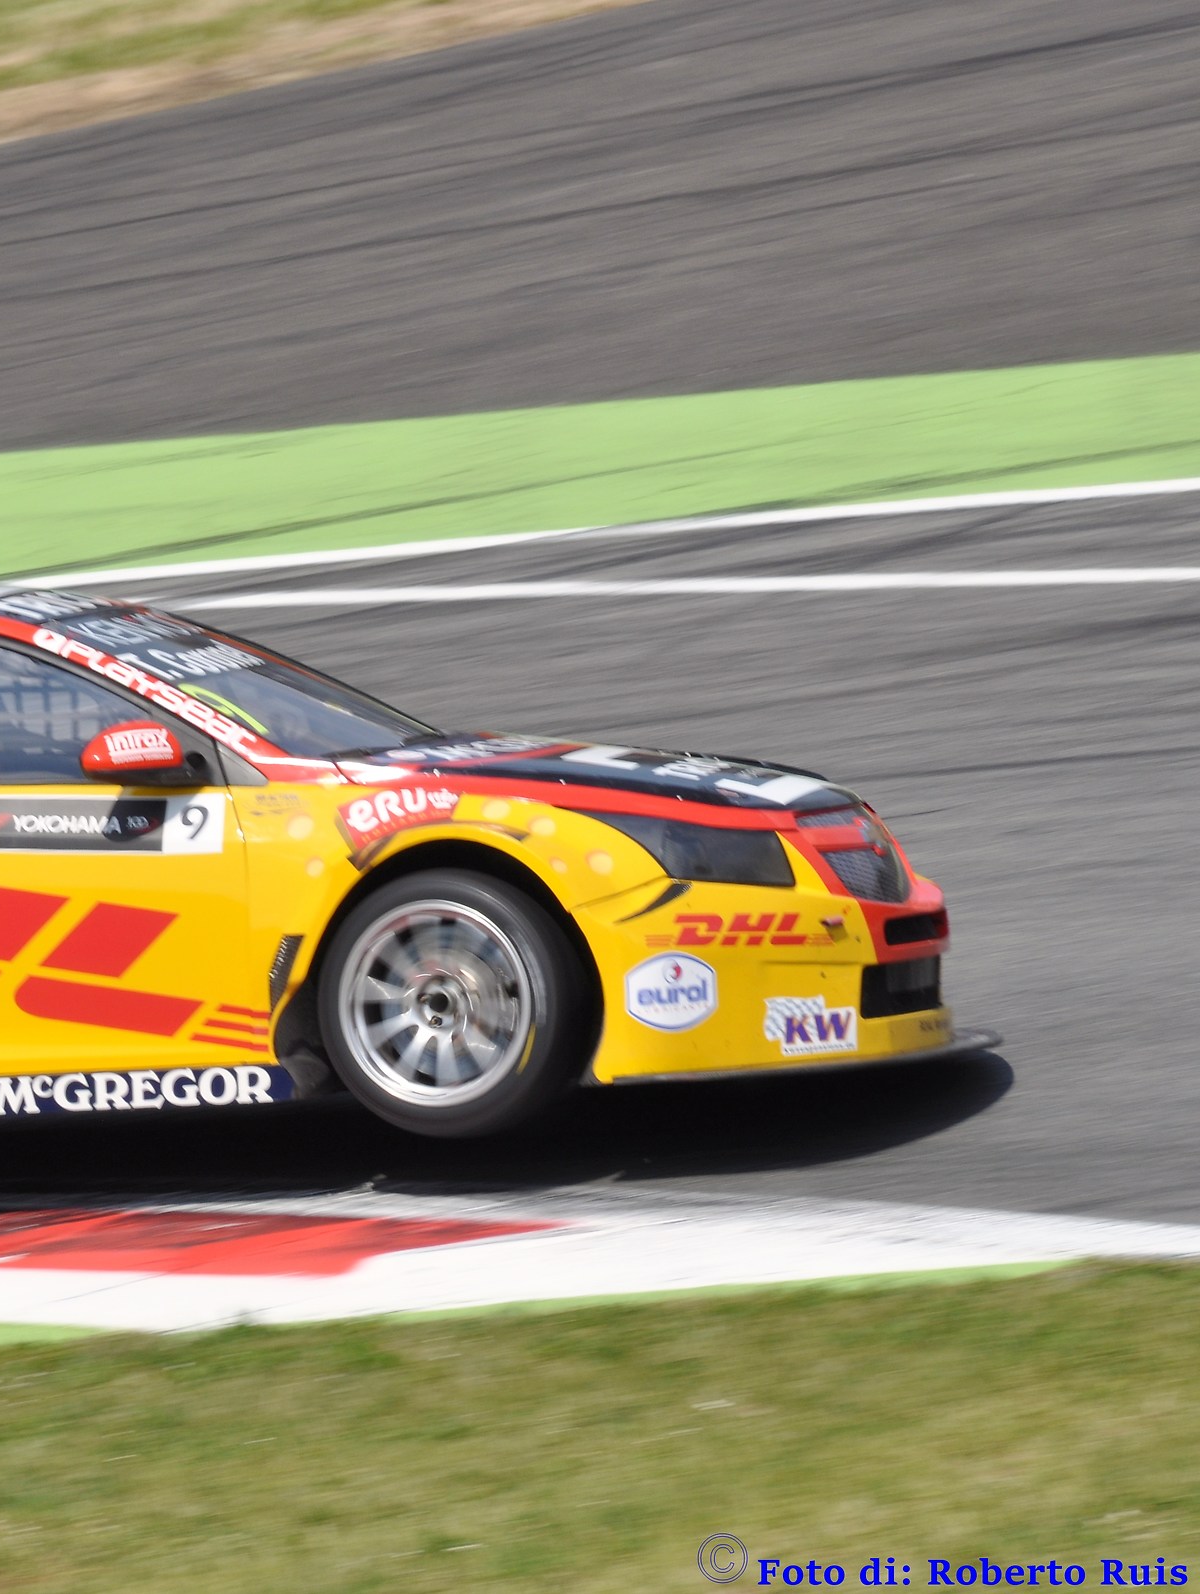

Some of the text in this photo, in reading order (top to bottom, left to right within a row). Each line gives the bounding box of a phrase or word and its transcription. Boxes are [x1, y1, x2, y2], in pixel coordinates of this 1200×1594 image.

[11, 814, 122, 834] YOKOHAMA
[182, 806, 209, 839] 9
[674, 913, 808, 946] DHL
[637, 979, 708, 1006] eurol
[785, 1010, 852, 1045] KW
